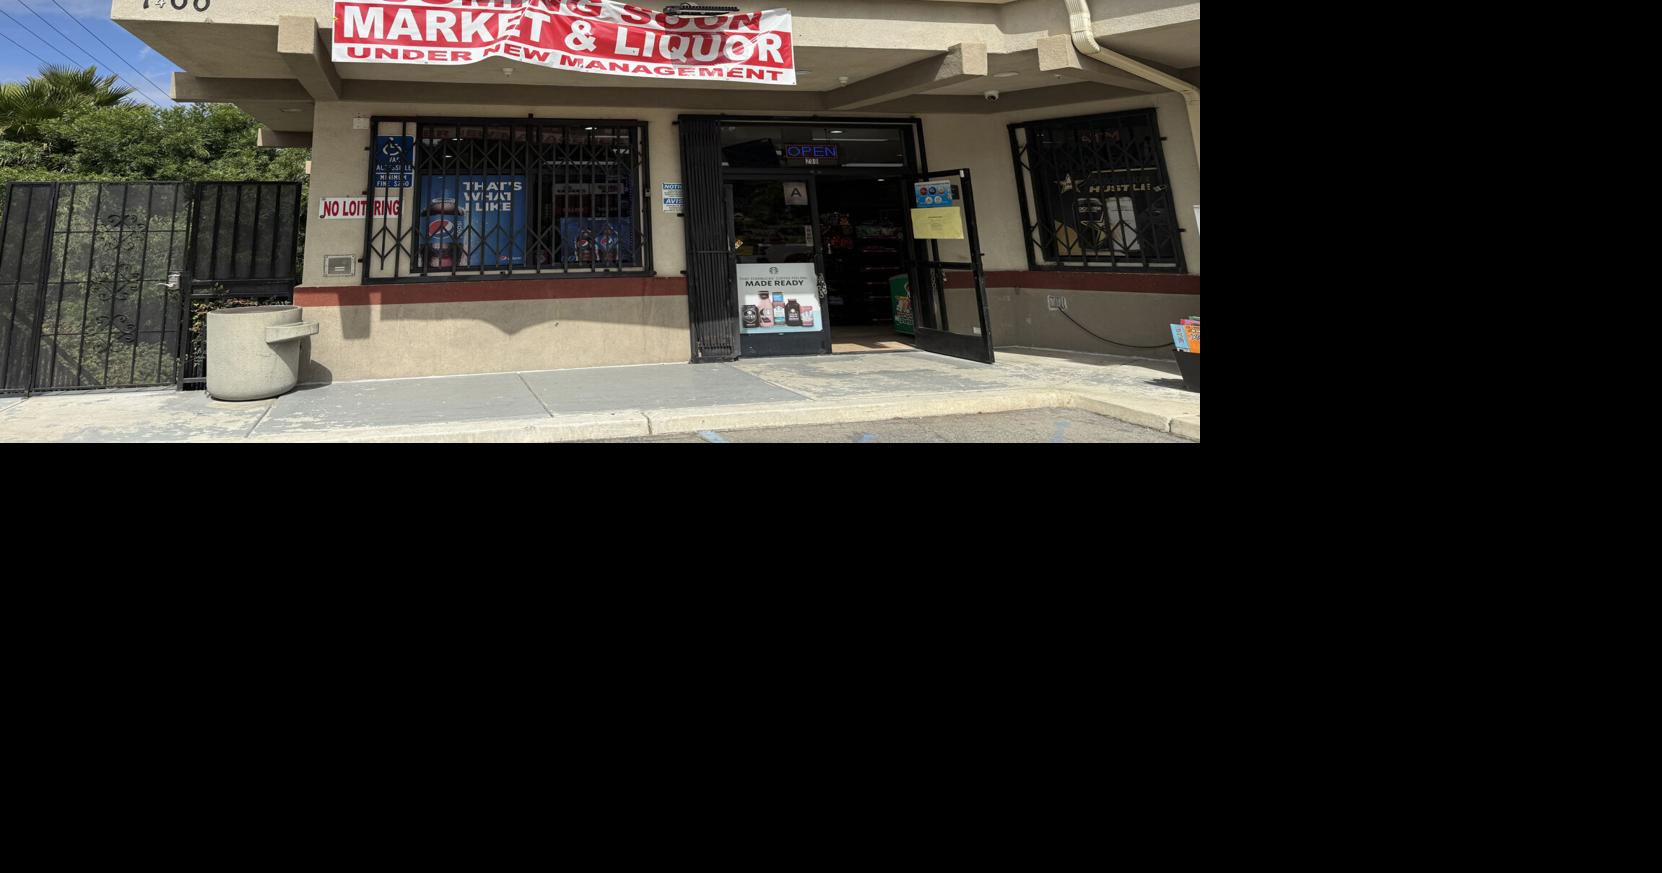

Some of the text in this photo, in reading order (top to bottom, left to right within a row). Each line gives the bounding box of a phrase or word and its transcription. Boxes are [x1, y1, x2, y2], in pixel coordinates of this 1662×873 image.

[621, 4, 763, 31] SOON
[343, 5, 551, 43] MARKET
[564, 19, 597, 52] &
[614, 26, 785, 64] LIQUOR
[346, 43, 784, 81] UNDER NEW MANAGEMENT
[787, 146, 837, 157] OPEN
[462, 181, 522, 191] THAT'S
[463, 191, 512, 201] WHAT
[791, 187, 802, 198] A
[323, 200, 401, 217] NO LOITRING
[475, 202, 512, 212] LIKE
[774, 279, 805, 287] READY
